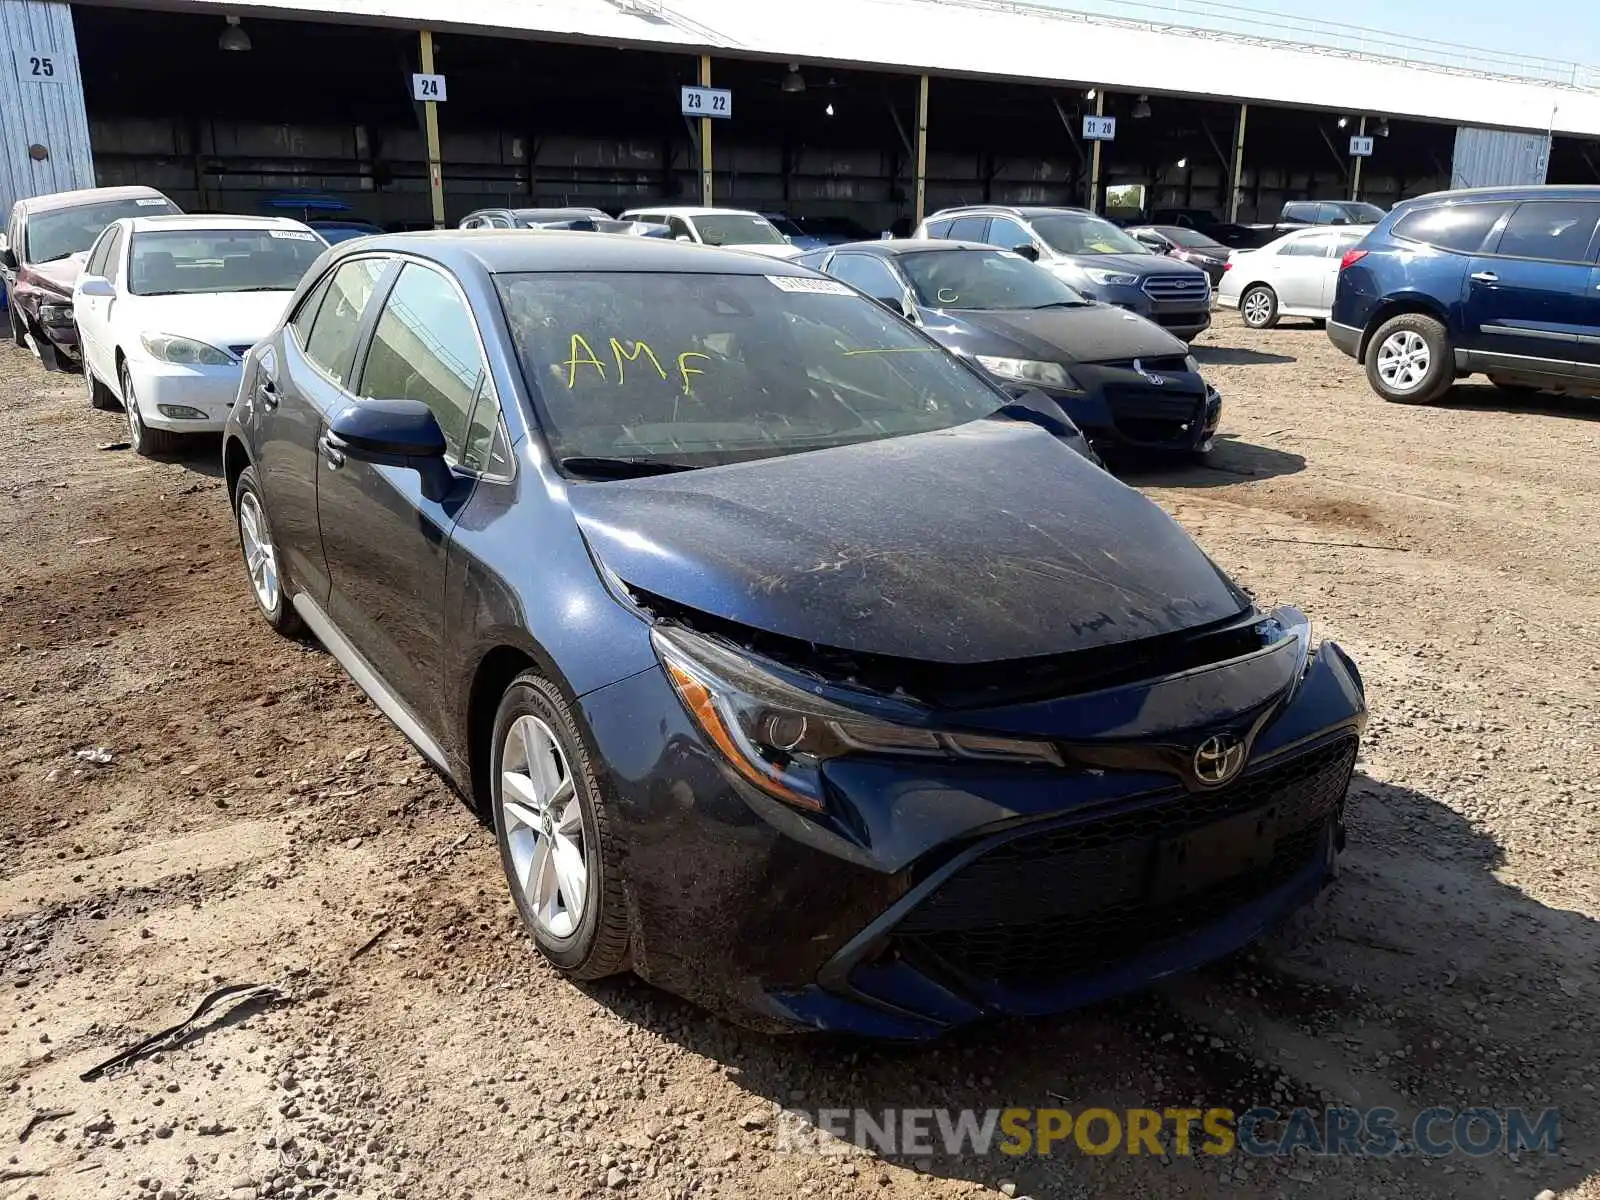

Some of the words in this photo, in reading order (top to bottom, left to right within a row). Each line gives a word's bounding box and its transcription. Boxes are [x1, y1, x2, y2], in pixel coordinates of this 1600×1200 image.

[30, 57, 54, 77] 25
[421, 79, 438, 96] 24
[688, 93, 701, 108] 23
[712, 95, 725, 110] 22
